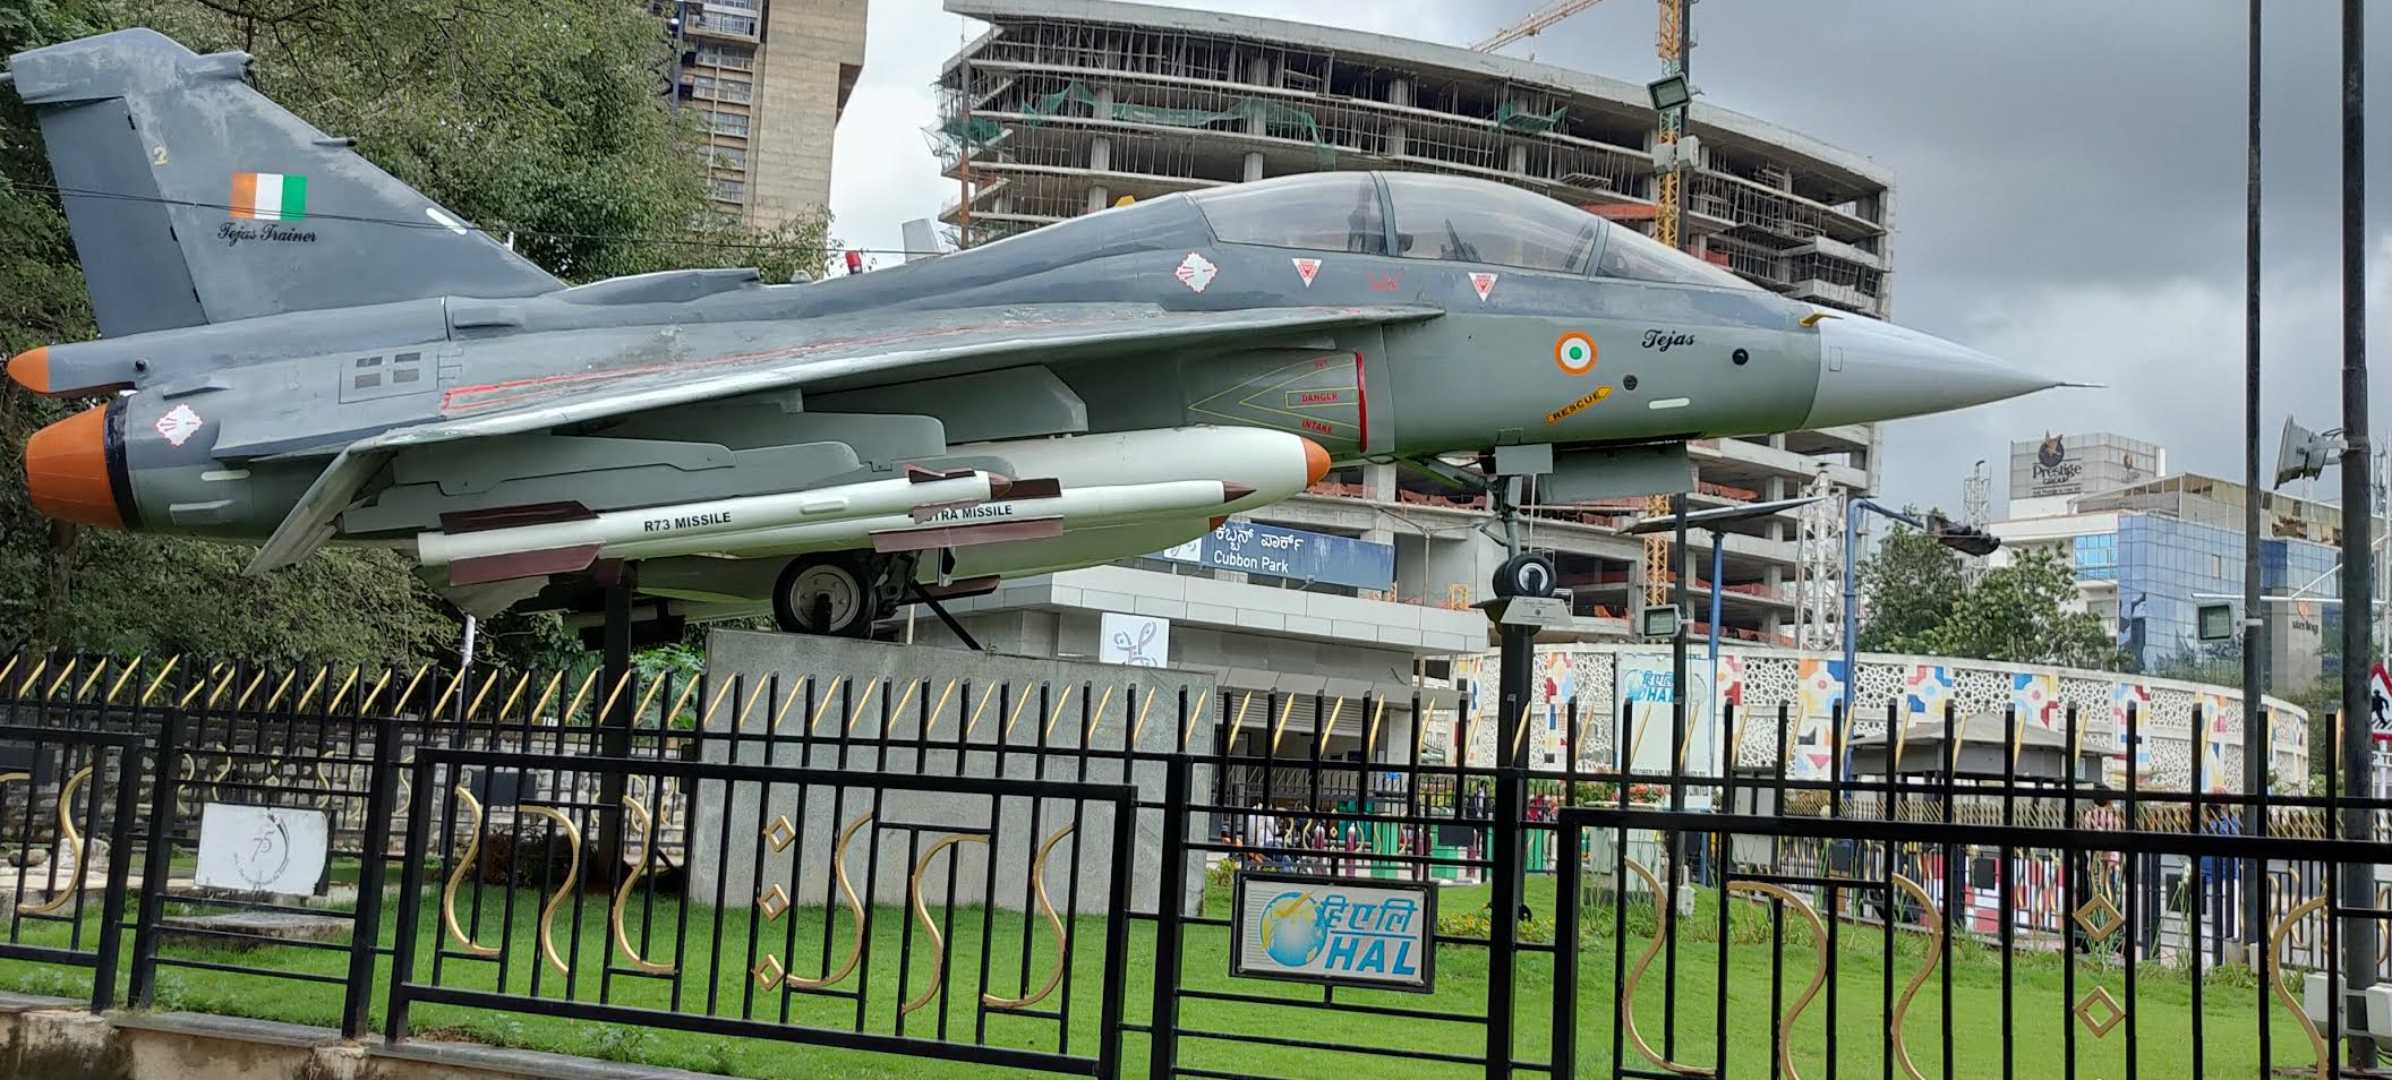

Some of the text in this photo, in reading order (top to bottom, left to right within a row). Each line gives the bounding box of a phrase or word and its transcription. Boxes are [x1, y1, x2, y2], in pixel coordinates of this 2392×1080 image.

[217, 222, 317, 247] Tejas Trainer
[1642, 329, 1695, 352] Tejas
[1302, 391, 1338, 403] DANGER
[1552, 391, 1600, 421] RESCUE
[644, 512, 731, 532] R73 MISSILE
[962, 504, 1013, 519] MISSILE
[1214, 550, 1288, 573] Cubbon Park
[1321, 895, 1418, 932] हिएलि
[1325, 935, 1416, 976] HAL
